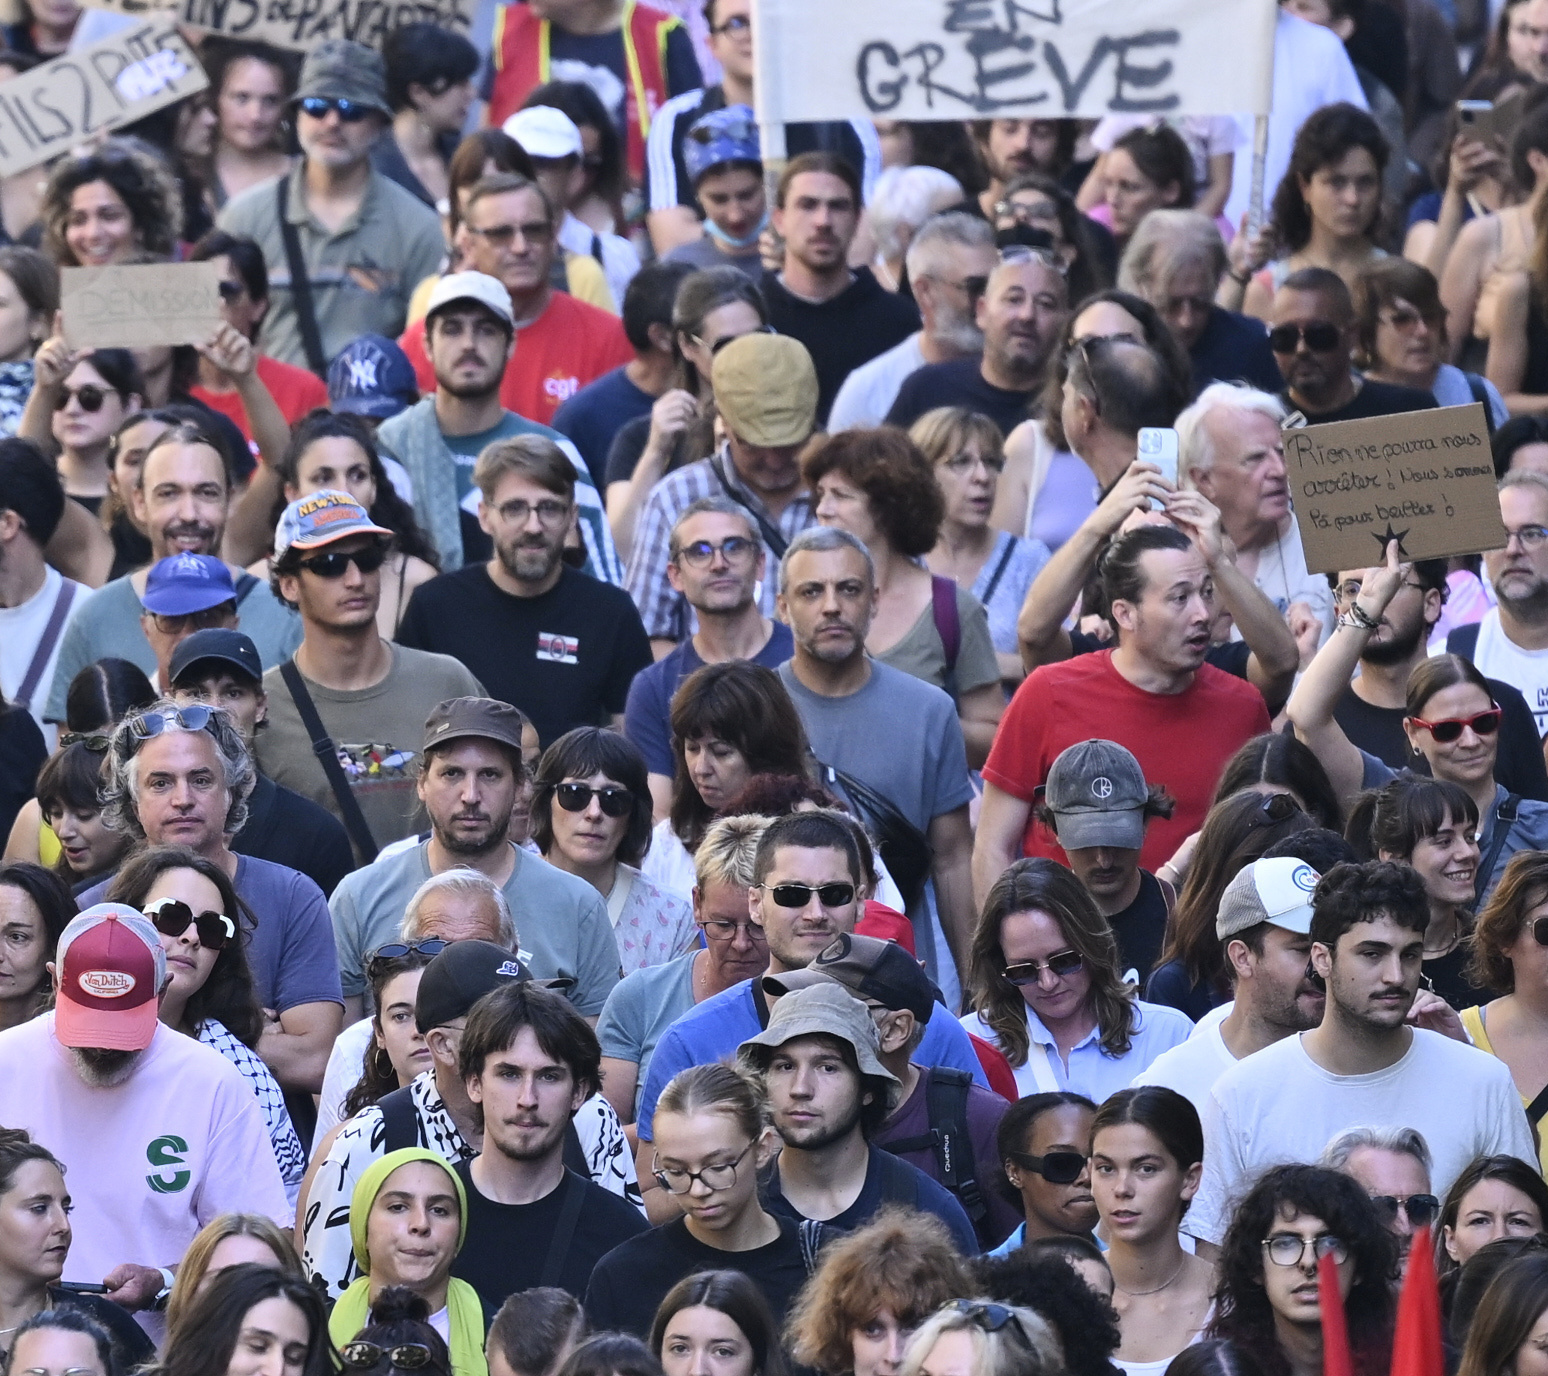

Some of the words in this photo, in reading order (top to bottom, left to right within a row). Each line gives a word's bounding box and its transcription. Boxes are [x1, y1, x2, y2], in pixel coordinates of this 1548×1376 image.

[1288, 432, 1352, 468] Rien
[1382, 438, 1437, 463] pourra
[1441, 432, 1482, 448] nous
